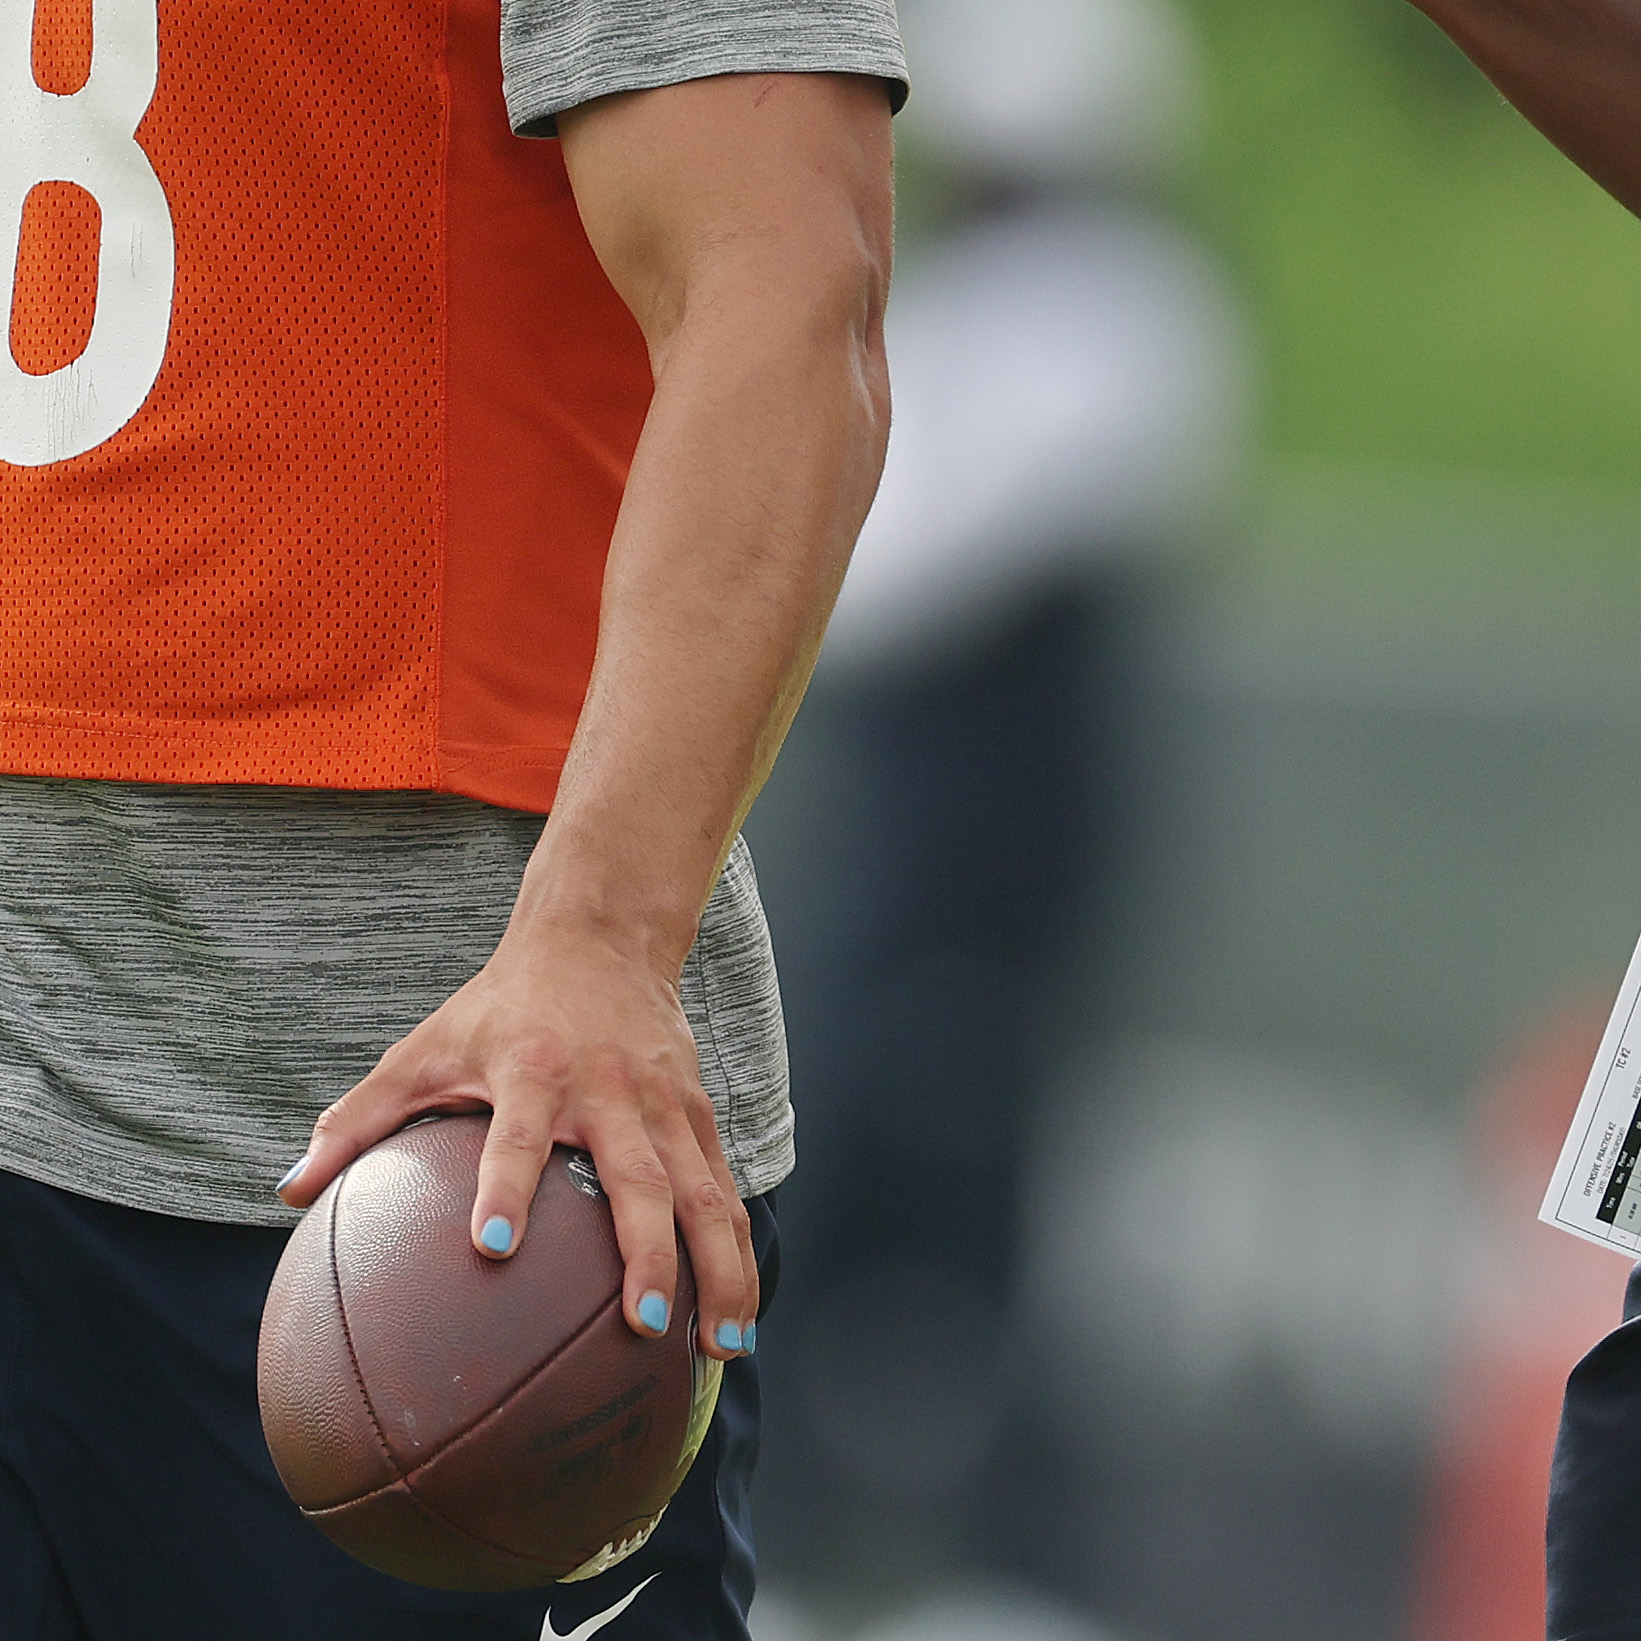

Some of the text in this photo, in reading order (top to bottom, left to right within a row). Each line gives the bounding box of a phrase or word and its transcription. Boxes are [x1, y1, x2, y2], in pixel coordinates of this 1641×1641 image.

[1615, 1046, 1631, 1069] TC #2
[1631, 1084, 1641, 1099] BASE
[1582, 1120, 1617, 1197] OFFENSIVE PRACTICE #2
[1595, 1179, 1607, 1194] DATE:
[1605, 1194, 1617, 1210] Time
